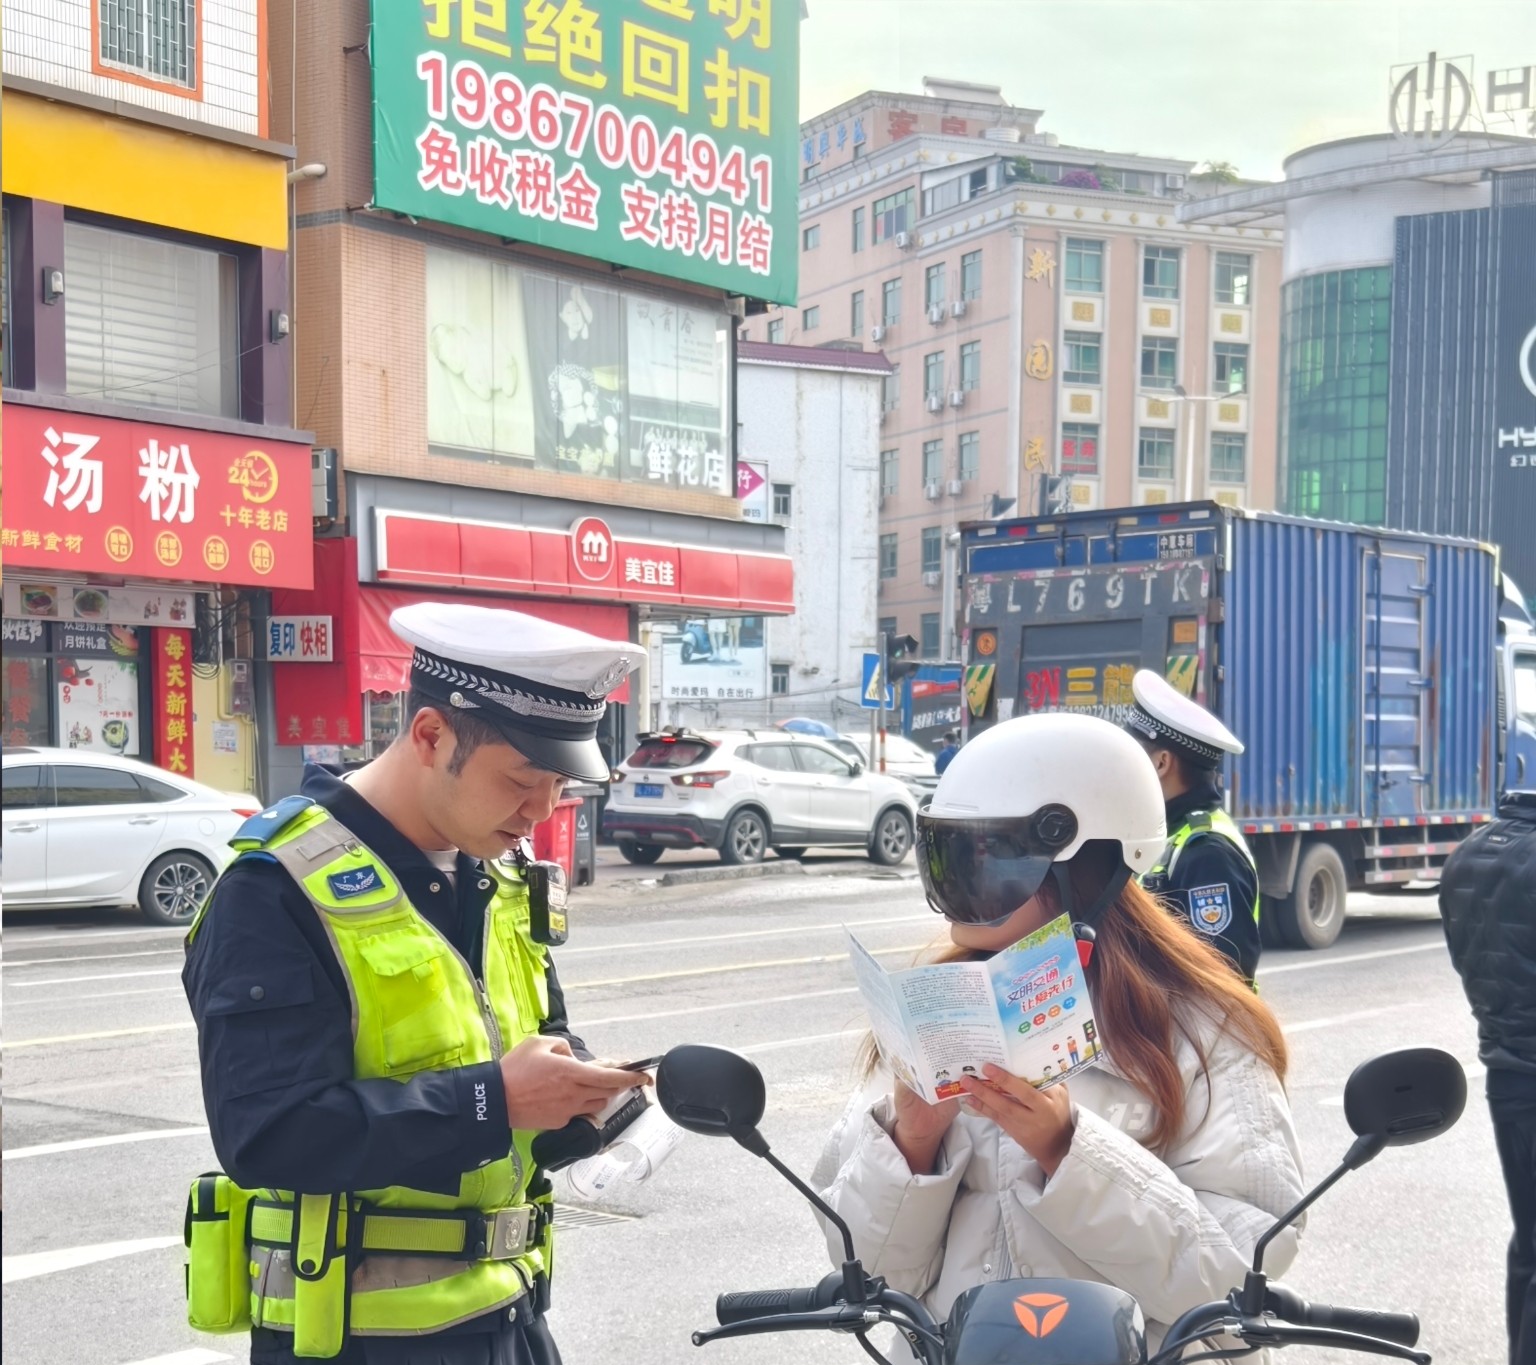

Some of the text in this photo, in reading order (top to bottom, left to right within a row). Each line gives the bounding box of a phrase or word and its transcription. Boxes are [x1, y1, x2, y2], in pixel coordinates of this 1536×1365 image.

[419, 52, 773, 211] 19867004941
[418, 127, 773, 275] 免收税金 支持月结
[41, 426, 200, 523] 汤粉
[228, 466, 250, 487] 24
[646, 442, 726, 490] 鲜花店
[220, 504, 289, 532] 十年老店
[2, 528, 83, 553] 新鲜食材
[624, 557, 676, 587] 美宜佳
[64, 635, 108, 651] 月饼礼盒
[269, 620, 329, 657] 复印 快相
[474, 1082, 488, 1121] POLICE
